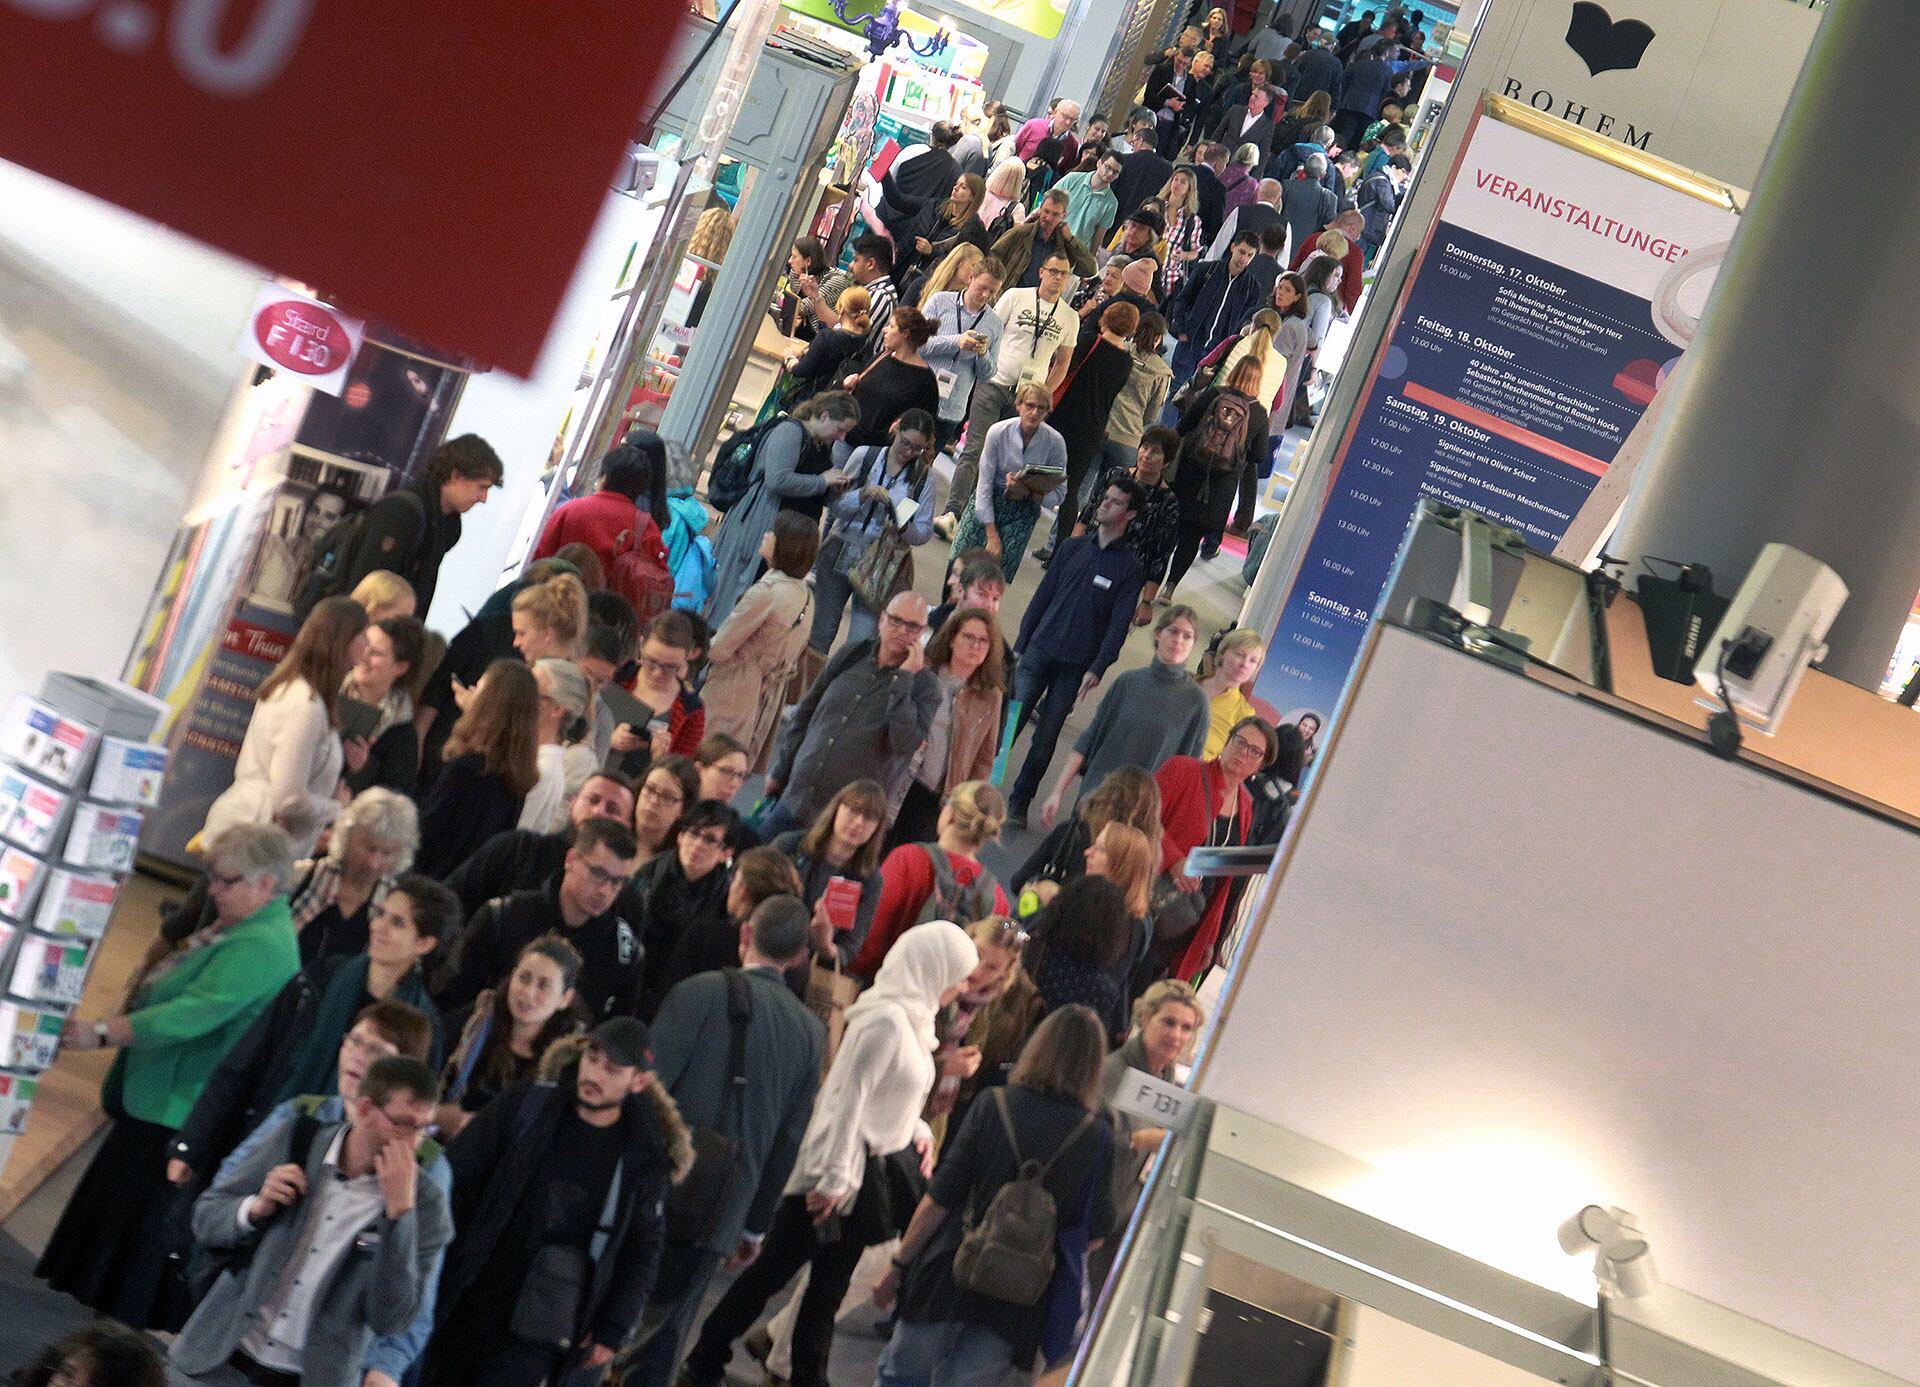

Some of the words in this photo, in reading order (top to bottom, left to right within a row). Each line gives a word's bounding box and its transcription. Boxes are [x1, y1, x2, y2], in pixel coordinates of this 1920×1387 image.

[1503, 76, 1654, 151] BOHEM
[1444, 242, 1507, 275] Donnerstag,
[1507, 267, 1524, 280] 17.
[1524, 272, 1567, 297] Oktober
[1458, 271, 1471, 281] Uhr
[1490, 304, 1500, 313] im
[1500, 308, 1532, 326] Gespräch
[1532, 321, 1544, 330] mit
[1543, 325, 1562, 337] Karin
[1494, 294, 1508, 305] mit
[1507, 299, 1530, 313] ihrem
[1529, 308, 1549, 321] Buch
[1497, 285, 1518, 299] Sofia
[1517, 293, 1546, 310] Nesrine
[1545, 304, 1566, 318] Srour
[1566, 312, 1582, 324] und
[1581, 318, 1606, 334] Nancy
[1604, 327, 1623, 340] Herz
[266, 323, 288, 347] F
[1409, 335, 1429, 348] 13.00
[1429, 343, 1443, 353] Uhr
[1415, 315, 1455, 339] Freitag,
[1456, 330, 1473, 343] 18.
[1472, 336, 1516, 360] Oktober
[1469, 358, 1481, 368] 40
[1478, 361, 1500, 375] Jahre
[1516, 376, 1557, 397] unendliche
[1459, 386, 1472, 396] mit
[1470, 389, 1520, 414] anschließender
[1518, 409, 1564, 433] Signierstunde
[1462, 376, 1473, 385] im
[1471, 379, 1503, 398] Gespräch
[1503, 392, 1515, 402] mit
[1515, 397, 1529, 407] Ute
[1527, 402, 1563, 422] Wegmann
[1562, 414, 1623, 444] (Deutschlandfunk)
[1465, 367, 1501, 386] Sebastian
[1501, 380, 1555, 407] Meschenmoser
[1554, 401, 1571, 413] und
[1570, 407, 1596, 423] Roman
[1596, 418, 1620, 433] Hocke
[1377, 415, 1397, 428] 11.00
[1397, 423, 1411, 434] Uhr
[1384, 395, 1432, 422] Samstag,
[1432, 413, 1449, 427] 19.
[1448, 419, 1492, 443] Oktober
[1369, 437, 1389, 450] 12.00
[1389, 445, 1403, 455] Uhr
[1436, 438, 1478, 461] Signierzeit
[1476, 453, 1490, 464] mit
[1489, 459, 1512, 473] Oliver
[1512, 467, 1537, 482] Scherz
[1360, 458, 1381, 471] 12.30
[1380, 466, 1394, 477] Uhr
[1348, 489, 1369, 502] 13.00
[1367, 496, 1383, 507] Uhr
[1428, 459, 1468, 481] Signierzeit
[1467, 475, 1481, 485] mit
[1480, 480, 1516, 499] Sebastian
[1516, 494, 1570, 521] Meschenmoser
[1419, 481, 1441, 496] Ralph
[1441, 490, 1470, 507] Caspers
[1470, 500, 1486, 512] liest
[1486, 508, 1500, 518] aus
[1525, 522, 1550, 537] Riesen
[1336, 519, 1357, 532] 13.00
[1355, 526, 1370, 537] Uhr
[1321, 558, 1341, 572] 16.00
[1340, 565, 1355, 577] Uhr
[1306, 590, 1354, 617] Sonntag,
[1353, 608, 1370, 622] 20.
[1319, 618, 1334, 629] Uhr
[1685, 614, 1702, 656] SHURE
[1311, 639, 1326, 650] Uhr
[1299, 670, 1313, 682] Uhr
[1136, 1084, 1152, 1101] F
